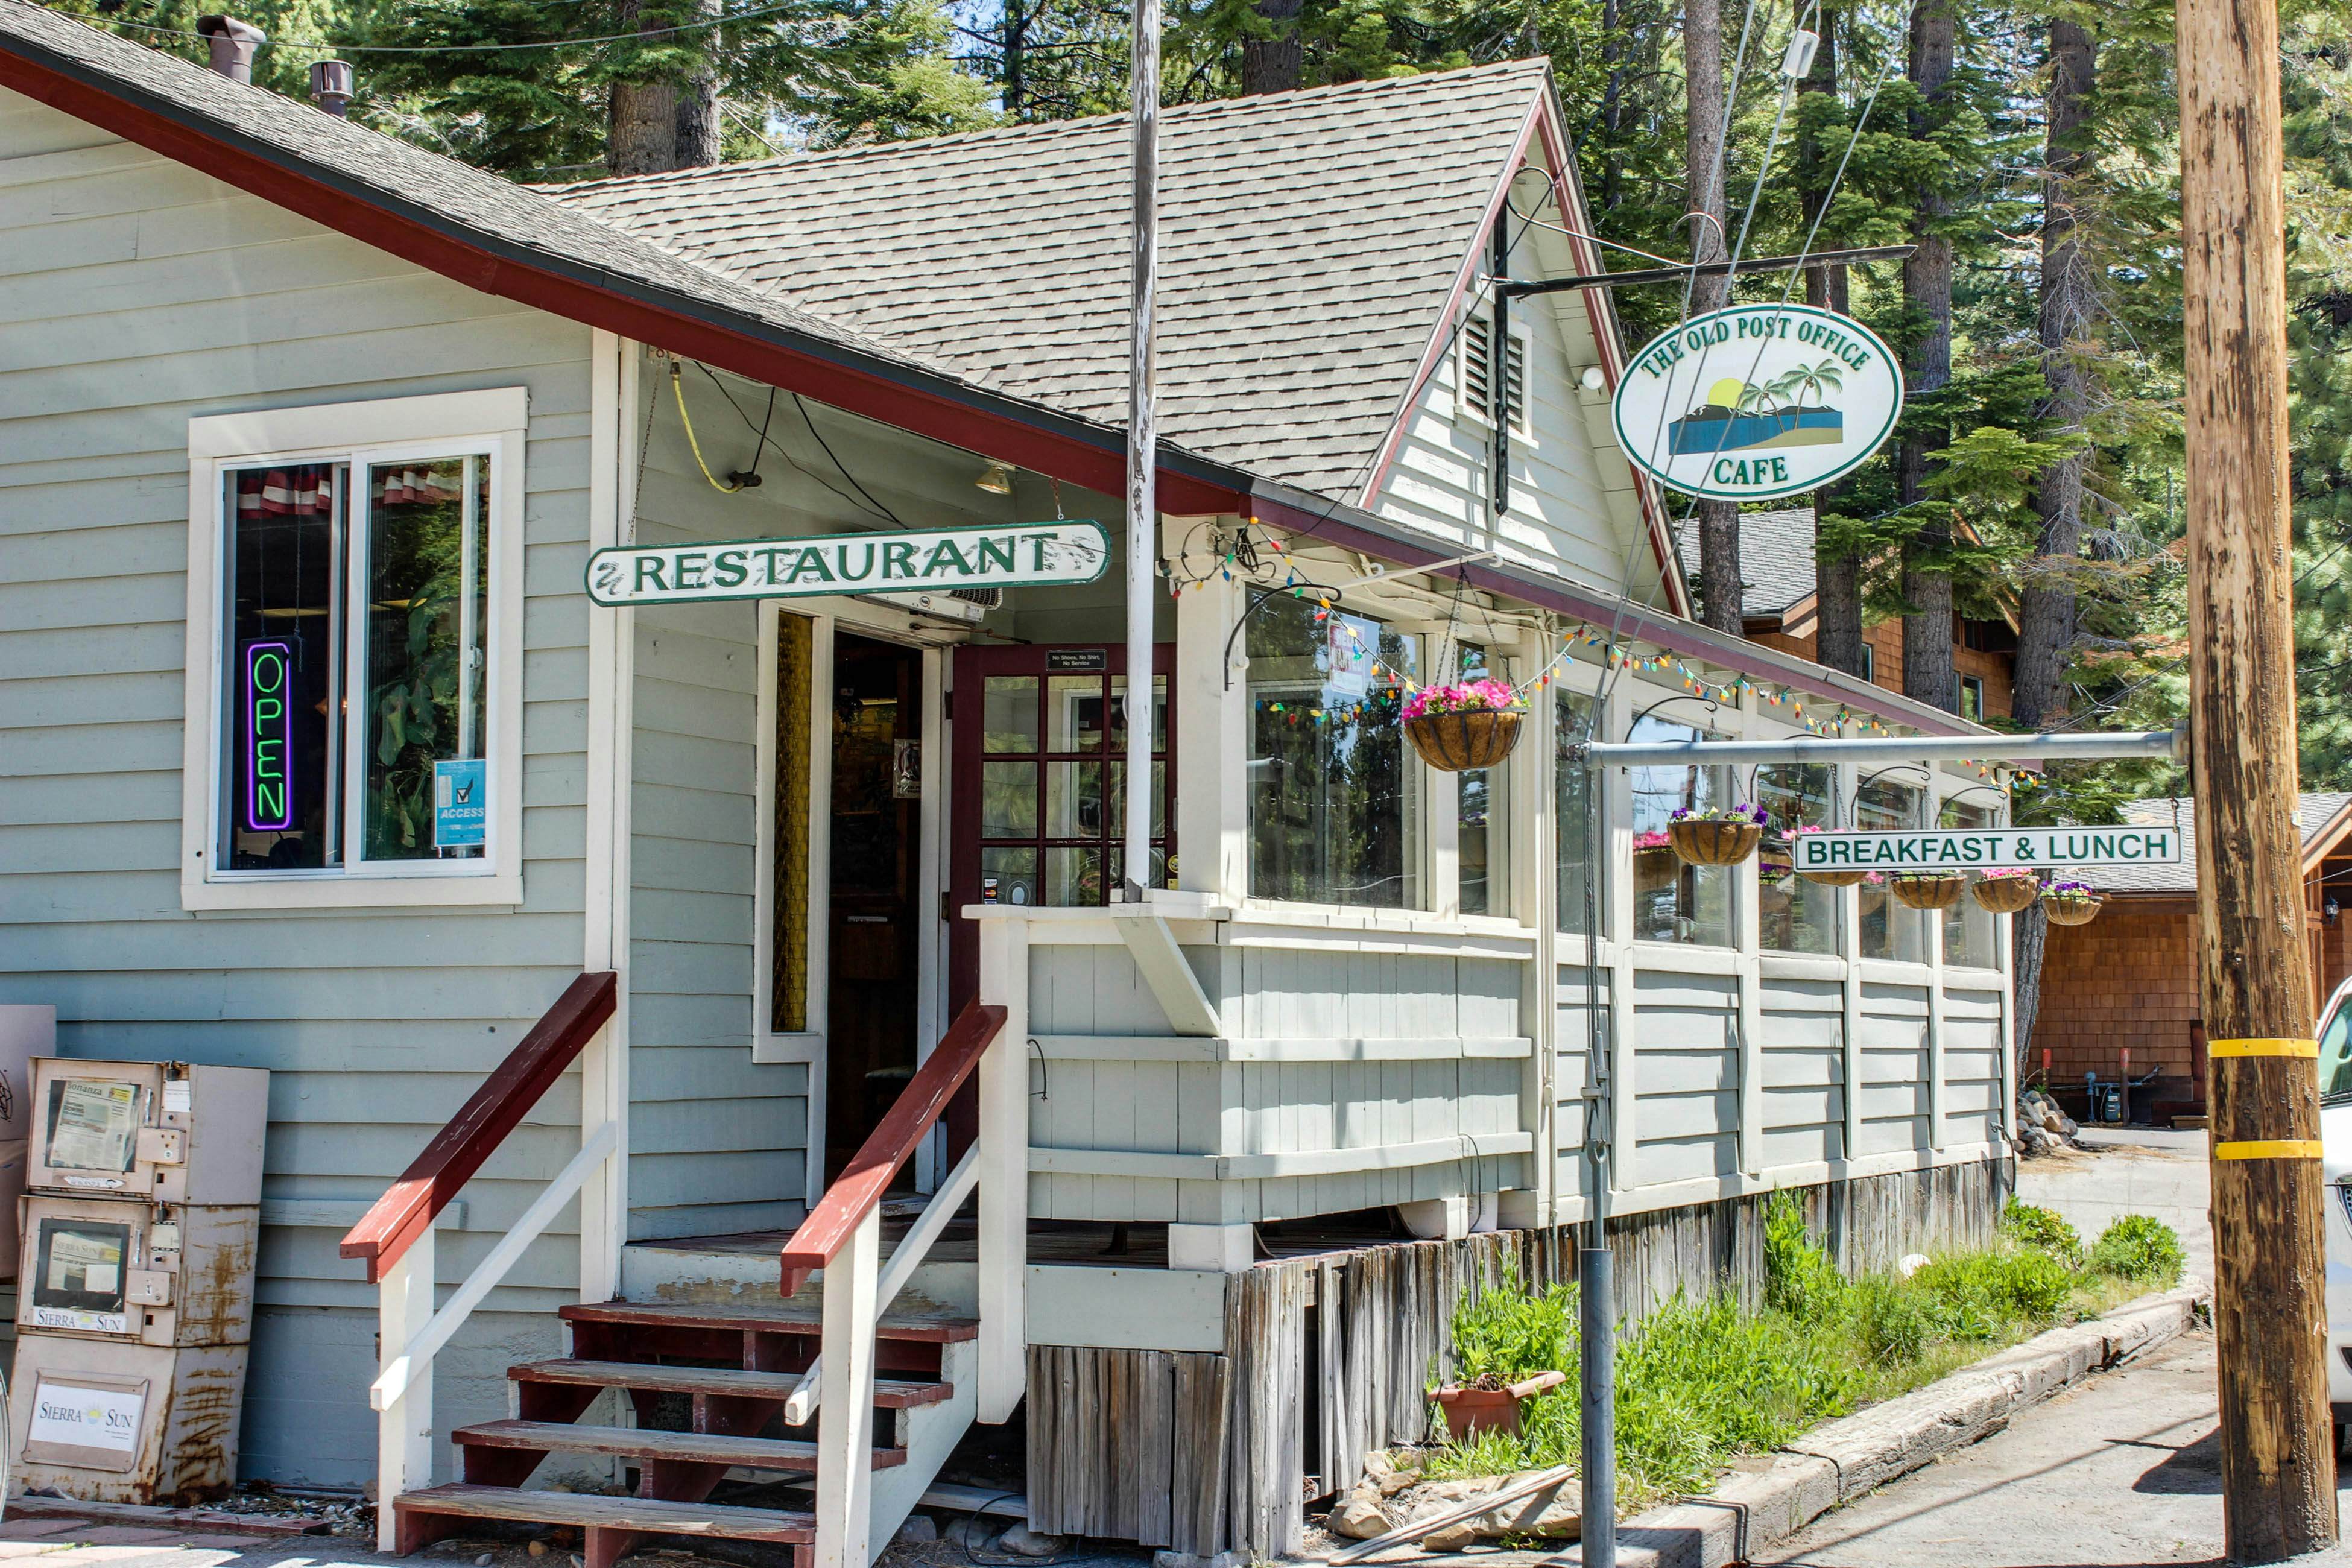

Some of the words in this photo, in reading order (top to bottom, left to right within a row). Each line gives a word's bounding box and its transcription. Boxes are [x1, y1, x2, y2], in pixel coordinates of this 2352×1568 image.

[1640, 339, 1684, 379] THE
[1687, 321, 1730, 351] OLD
[1737, 317, 1792, 338] POST
[1798, 321, 1871, 372] OFFICE
[1714, 456, 1788, 485] CAFE
[634, 533, 1058, 592] RESTAURANT
[254, 653, 284, 818] OPEN
[441, 807, 485, 819] ACCESS
[1807, 836, 2003, 864] BREAKFAST
[2014, 836, 2035, 860] &
[2049, 834, 2166, 860] LUNCH
[38, 1309, 75, 1327] SIERRA
[96, 1315, 121, 1331] SUN
[40, 1402, 82, 1423] SIERRA
[106, 1408, 133, 1428] SUN
